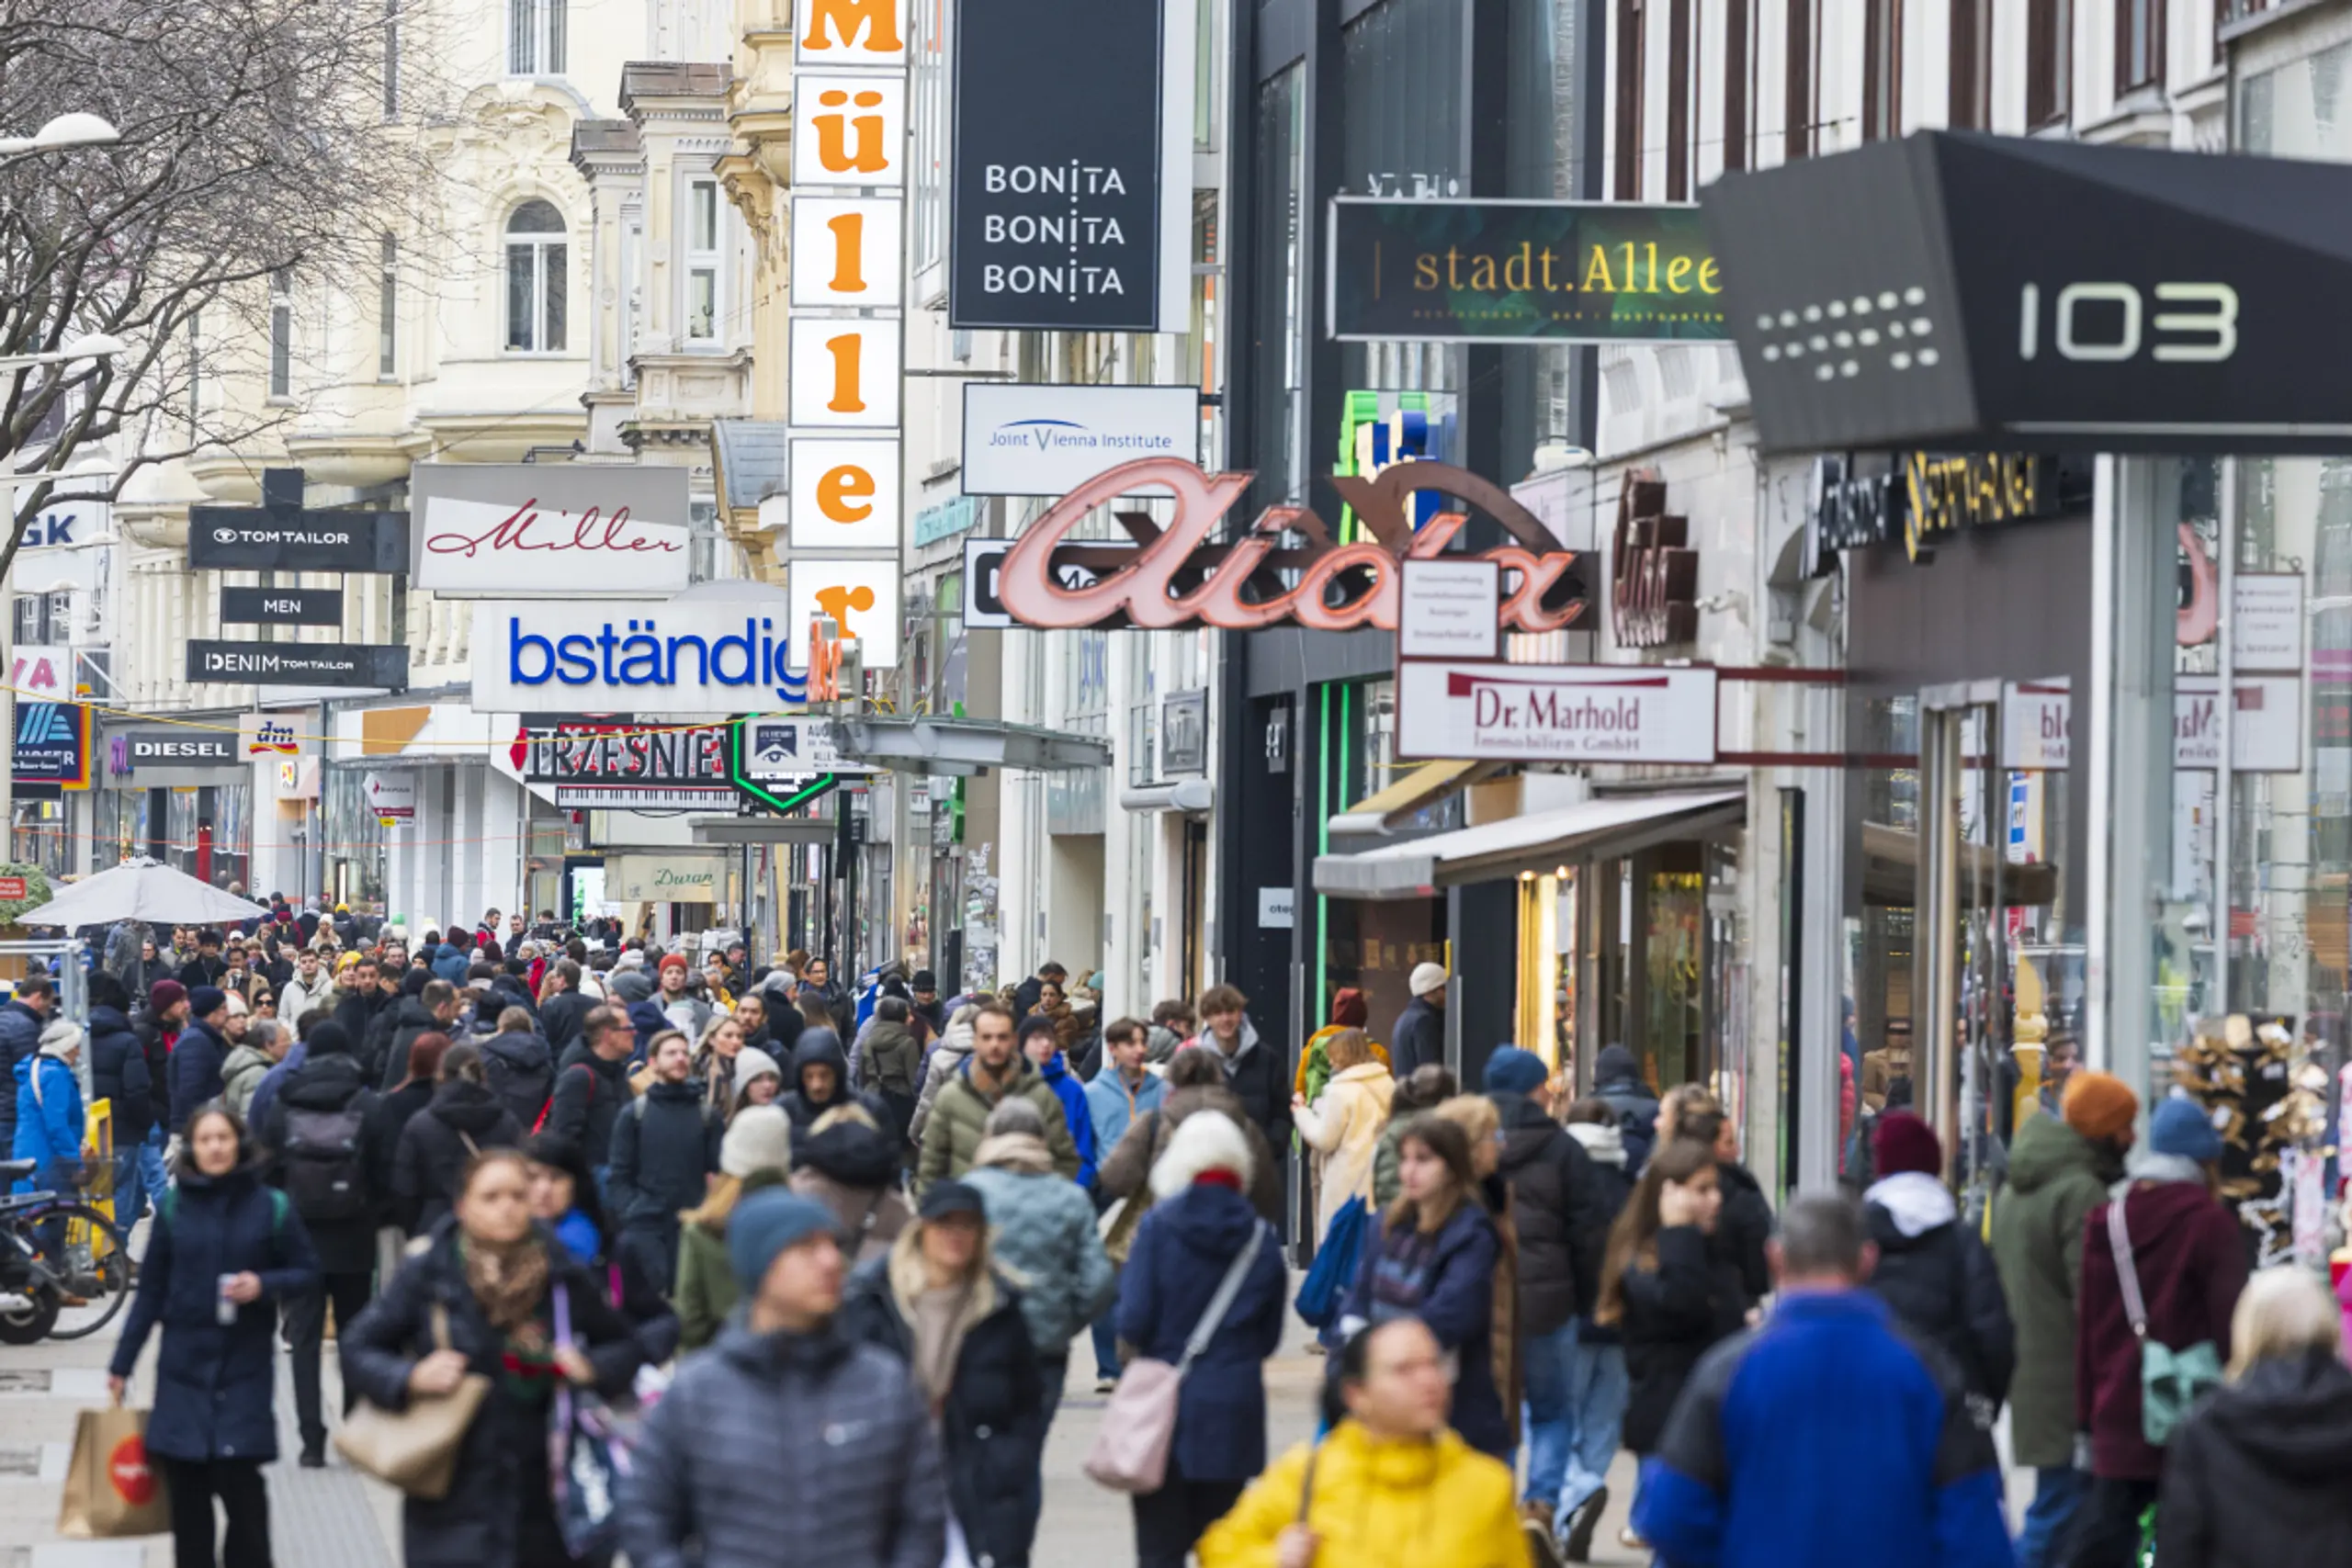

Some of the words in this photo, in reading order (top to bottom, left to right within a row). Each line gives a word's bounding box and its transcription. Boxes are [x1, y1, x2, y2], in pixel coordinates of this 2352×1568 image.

[984, 160, 1126, 201] BONITA
[983, 209, 1125, 253] BONITA
[982, 259, 1125, 301] BONITA
[2018, 281, 2239, 362] 103
[989, 432, 1029, 446] Joint
[1034, 427, 1098, 451] Vienna
[1102, 434, 1172, 448] Institute
[239, 530, 280, 543] TOM
[283, 531, 350, 545] TAILOR
[426, 497, 684, 558] Miller
[263, 599, 302, 615] MEN
[205, 652, 279, 672] DENIM
[281, 660, 309, 670] TOM
[311, 660, 355, 671] TAILOR
[1476, 688, 1519, 729] Dr.
[1525, 688, 1641, 731] Marhold
[256, 721, 294, 743] dm
[1474, 730, 1576, 752] Immobilien
[134, 742, 230, 757] DIESEL
